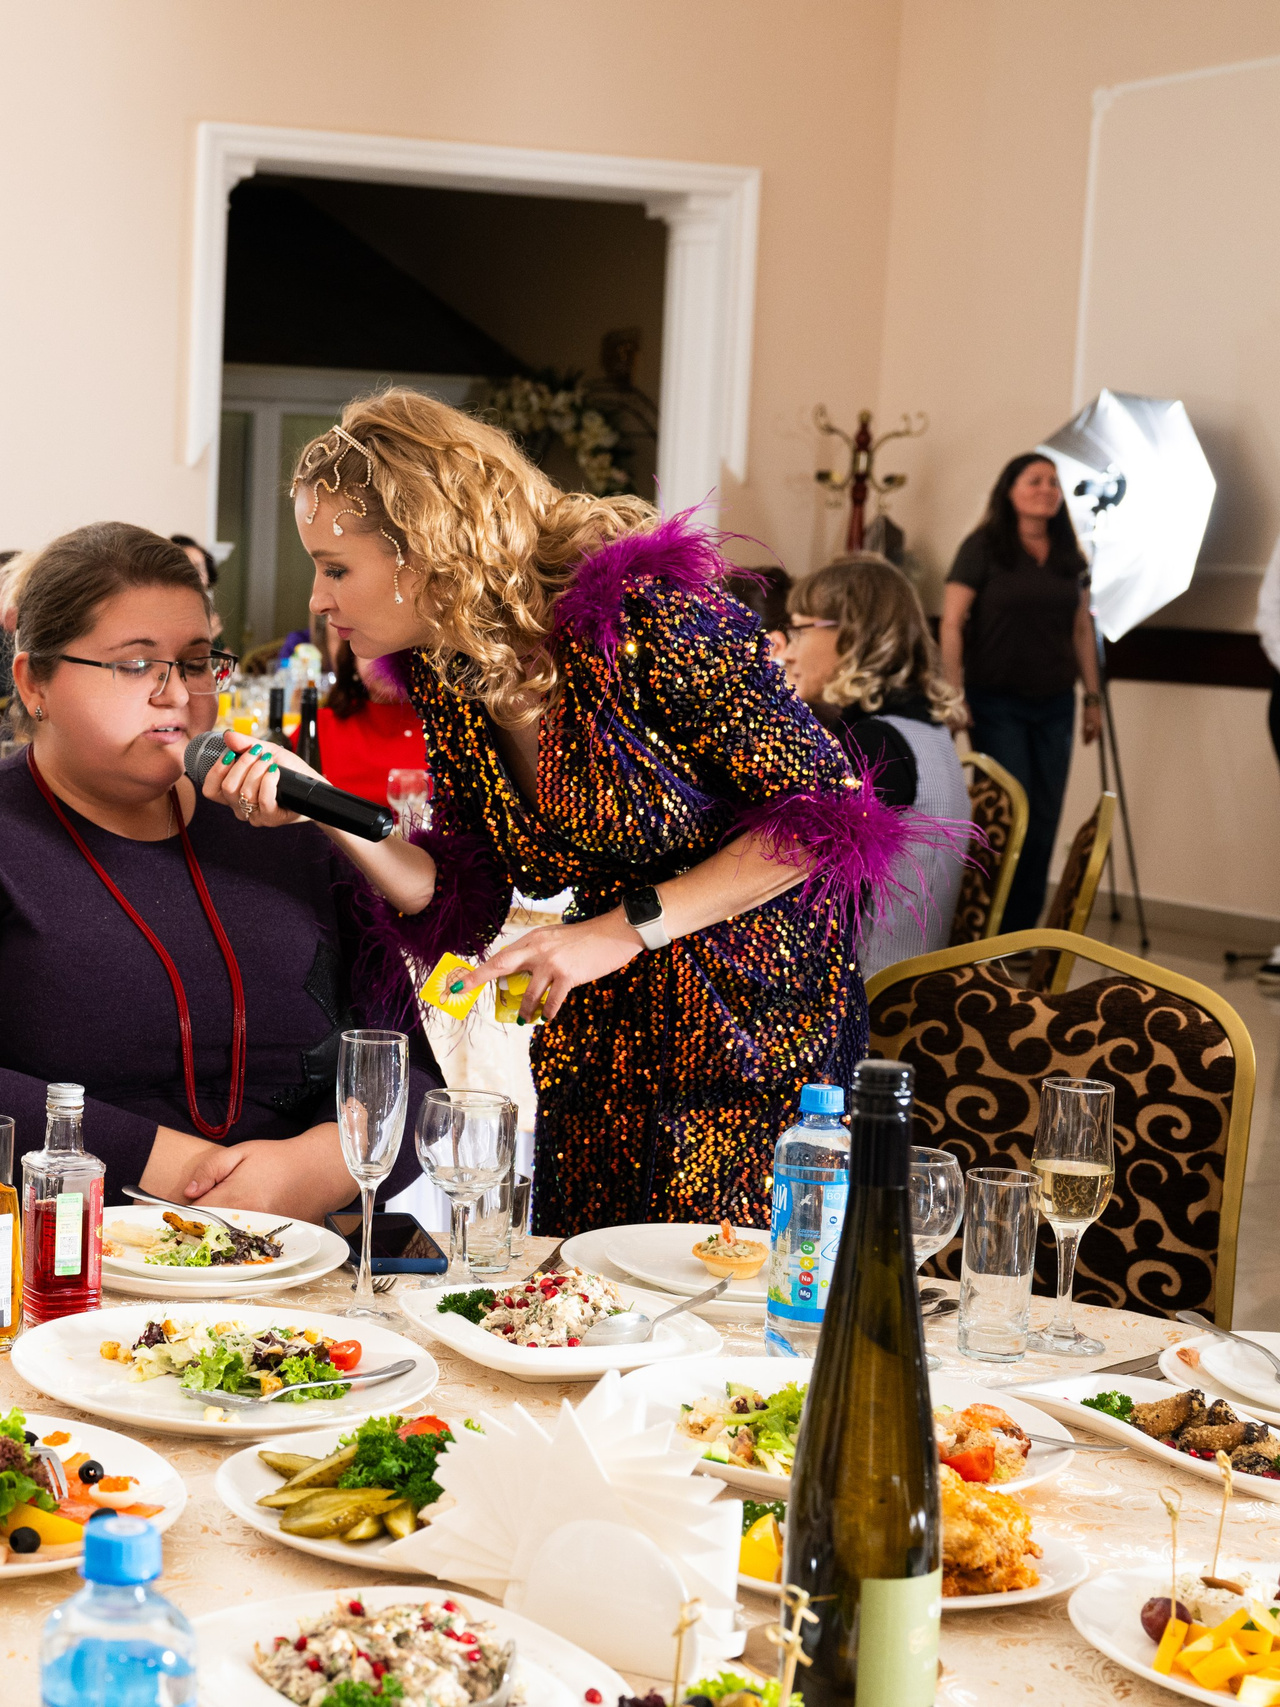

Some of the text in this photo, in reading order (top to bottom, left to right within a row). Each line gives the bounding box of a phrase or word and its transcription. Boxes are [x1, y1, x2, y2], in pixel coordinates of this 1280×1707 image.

[803, 1244, 813, 1252] Ca
[804, 1259, 810, 1267] K
[800, 1289, 811, 1298] Mg
